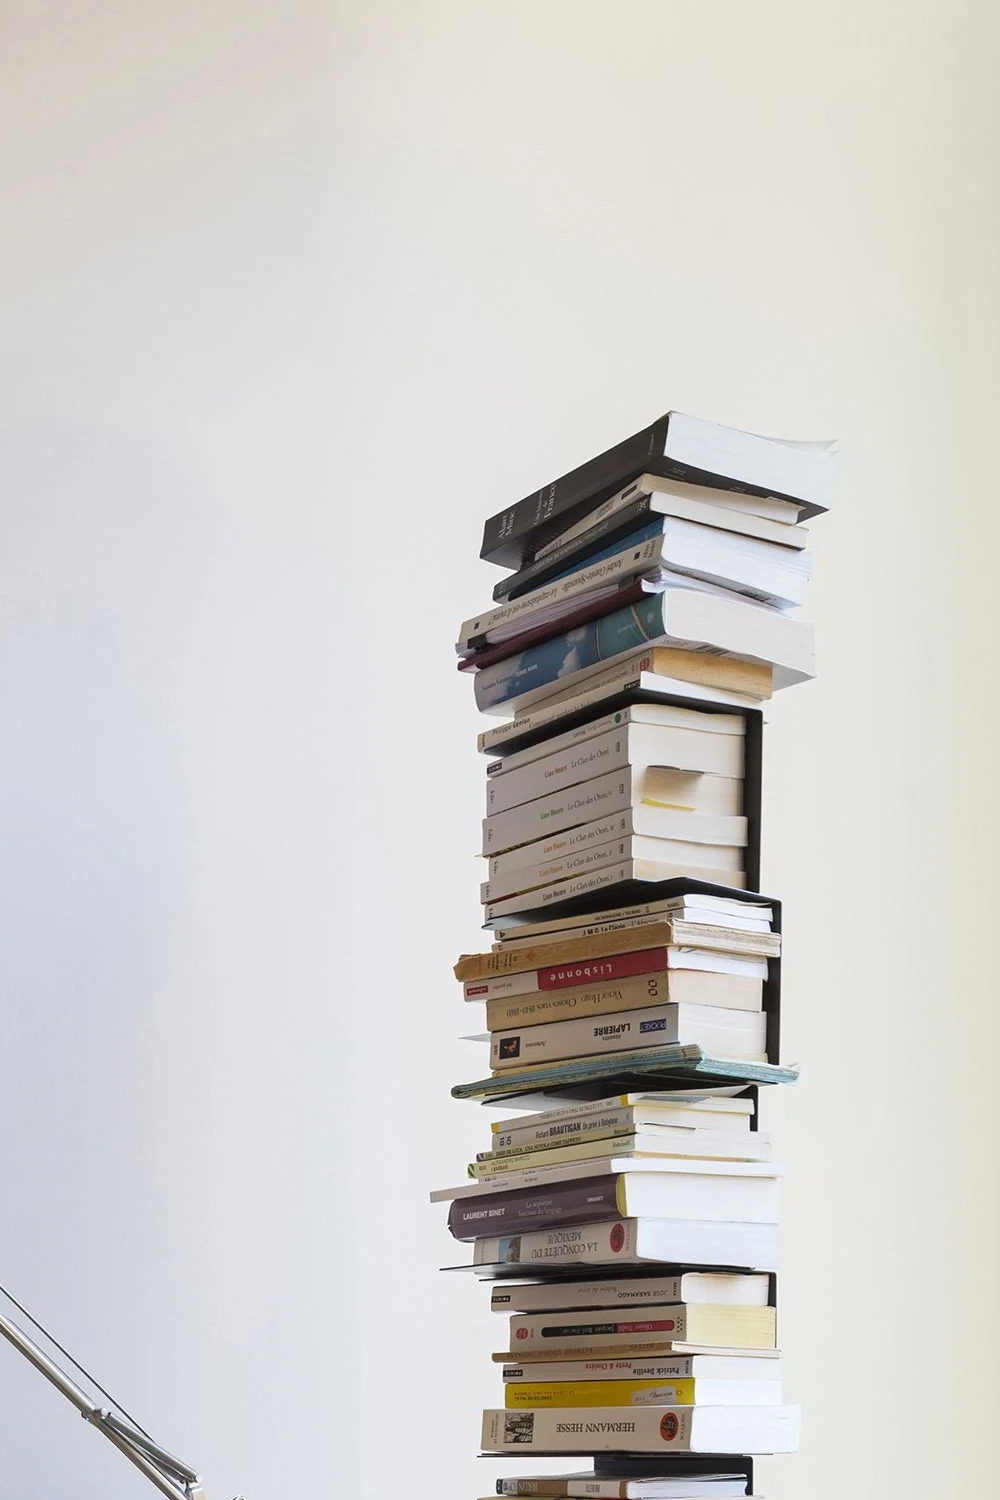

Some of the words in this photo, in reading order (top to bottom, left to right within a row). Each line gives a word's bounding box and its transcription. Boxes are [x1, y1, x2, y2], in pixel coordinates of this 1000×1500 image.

[578, 754, 587, 765] Clan
[574, 798, 584, 808] Clan
[576, 832, 586, 842] Clan
[574, 856, 584, 866] Clan
[576, 880, 586, 890] Clan
[550, 963, 611, 982] Lisbonne
[581, 992, 600, 1005] Hugo
[601, 989, 623, 1001] Victor
[552, 997, 577, 1010] Choses
[594, 1022, 631, 1036] LAPIERRE
[549, 1122, 580, 1136] BRAUTIGAN
[463, 1211, 487, 1220] LAURENT
[488, 1208, 505, 1217] BINET
[548, 1231, 582, 1243] MEXIQUE
[545, 1243, 585, 1258] CONQUÊTE
[588, 1241, 597, 1251] LA
[532, 1248, 543, 1257] DU
[657, 1366, 680, 1374] Patrick
[557, 1423, 583, 1432] HESSE
[586, 1422, 635, 1432] HERMANN
